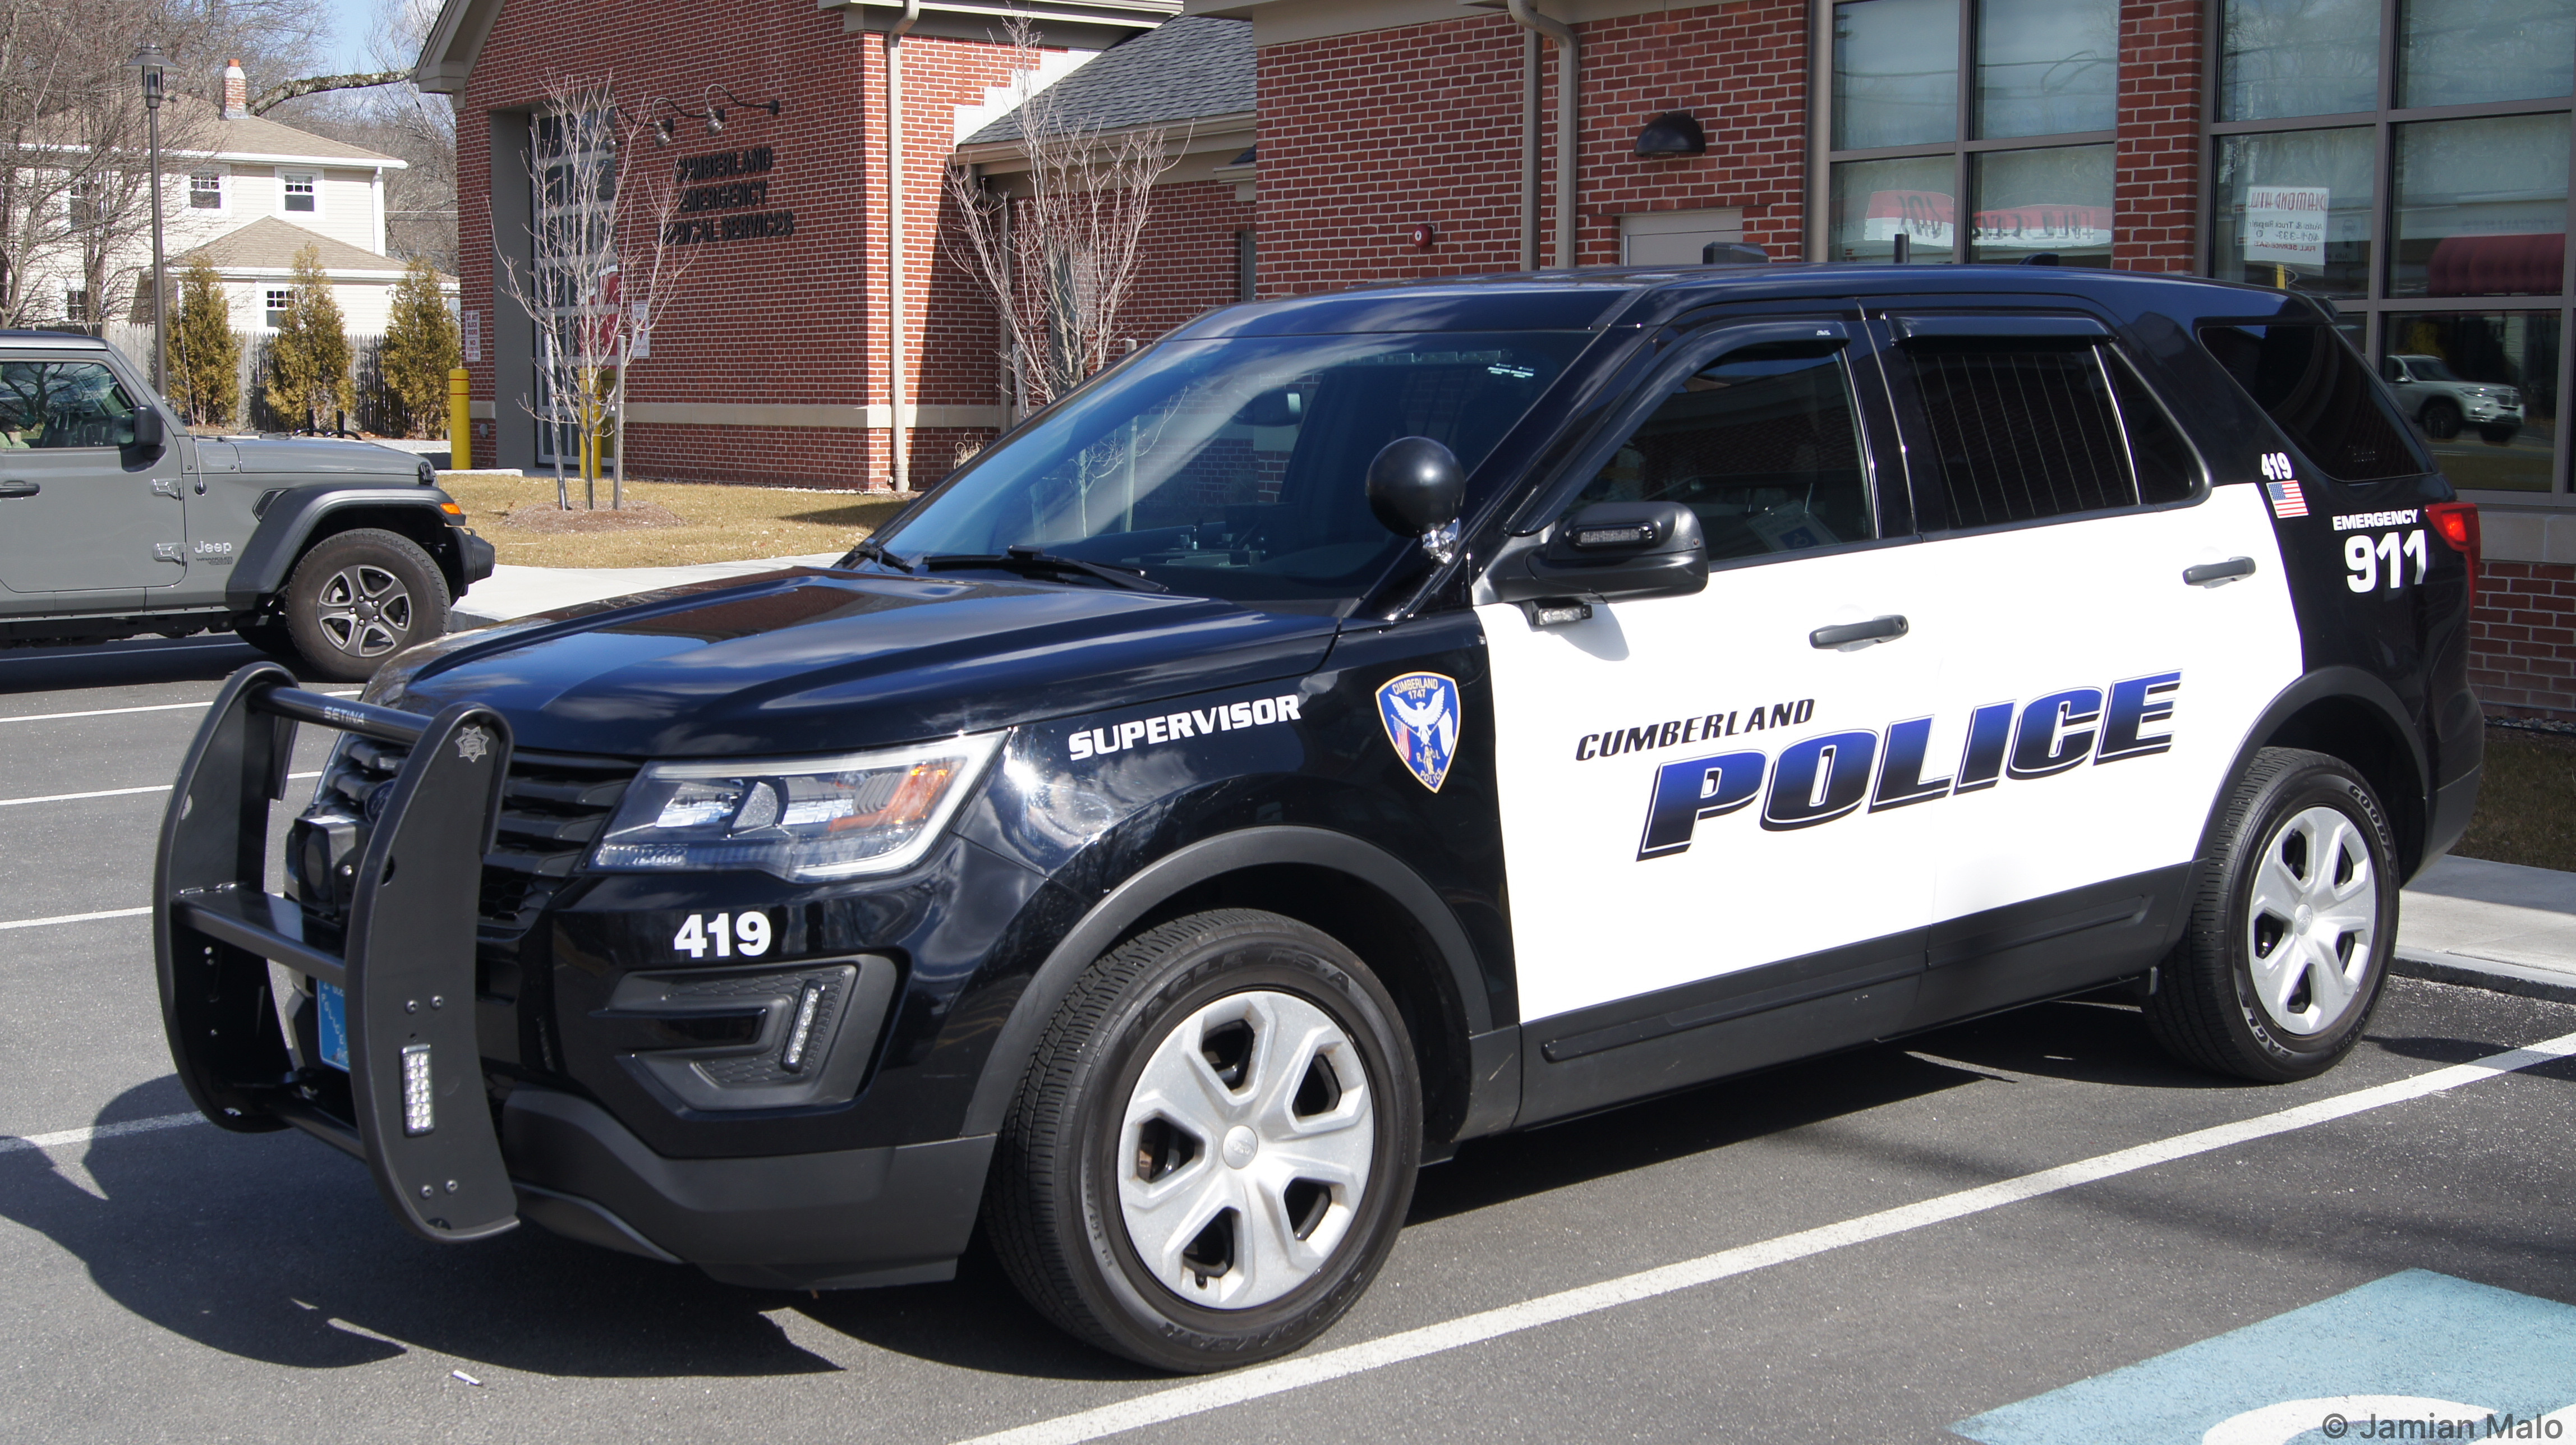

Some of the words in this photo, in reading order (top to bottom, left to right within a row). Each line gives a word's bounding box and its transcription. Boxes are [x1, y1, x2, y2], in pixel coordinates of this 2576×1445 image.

[675, 147, 772, 182] CUMBERLAND
[679, 180, 767, 213] EMERGENCY
[721, 211, 794, 241] SERVICES
[2261, 453, 2293, 480] 419
[2333, 509, 2418, 531] EMERGENCY
[194, 541, 232, 554] Jeep
[2344, 530, 2426, 593] 911
[1392, 678, 1439, 695] CUMBERLAND
[1408, 689, 1426, 700] 1747
[324, 706, 364, 725] SETINA
[1069, 695, 1301, 761] SUPERVISOR
[1576, 699, 1815, 761] CUMBERLAND
[1420, 767, 1443, 785] POLICE
[1636, 669, 2182, 862] POLICE
[674, 911, 771, 958] 419
[321, 993, 344, 1045] POLICE
[2238, 991, 2294, 1064] EAGLE
